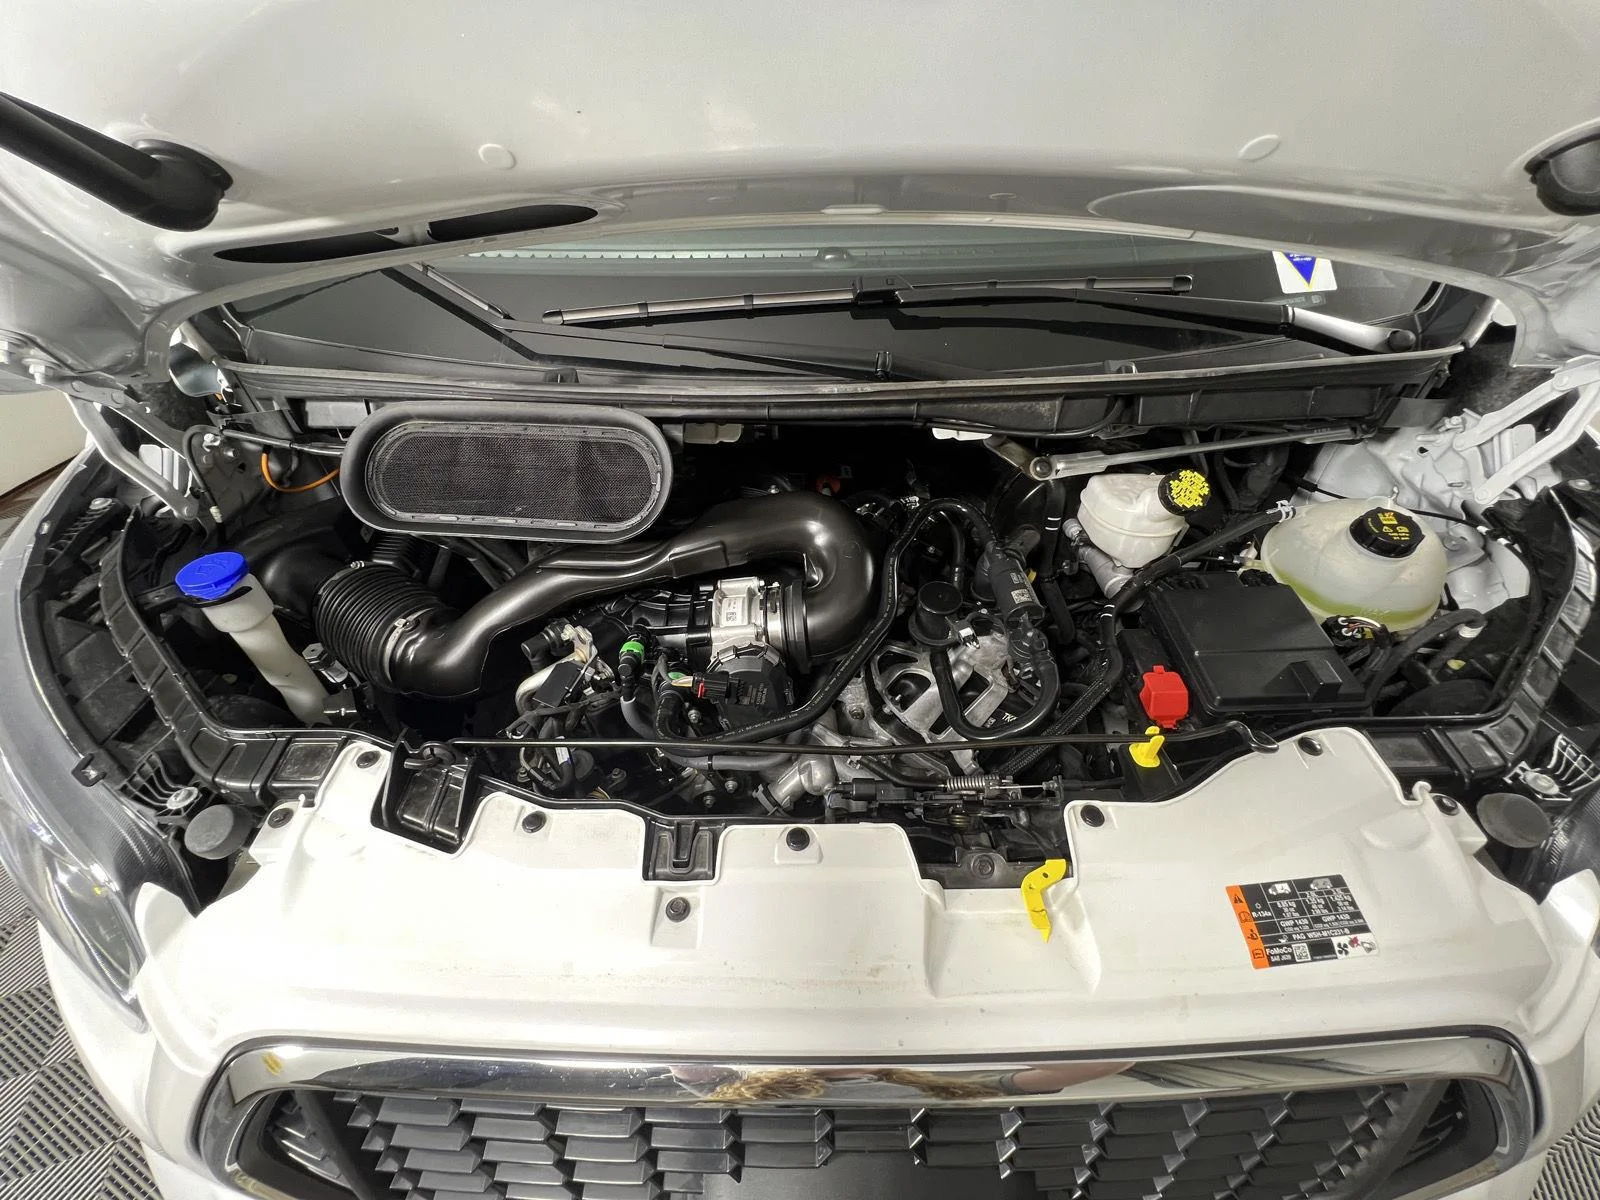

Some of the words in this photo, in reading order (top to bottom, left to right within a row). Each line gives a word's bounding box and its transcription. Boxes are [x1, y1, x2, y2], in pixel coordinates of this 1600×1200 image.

[1251, 910, 1272, 918] R-134a
[1336, 913, 1350, 921] 1430
[1294, 918, 1309, 926] 1430
[1292, 932, 1307, 941] PAG
[1265, 945, 1293, 956] FoMoCo
